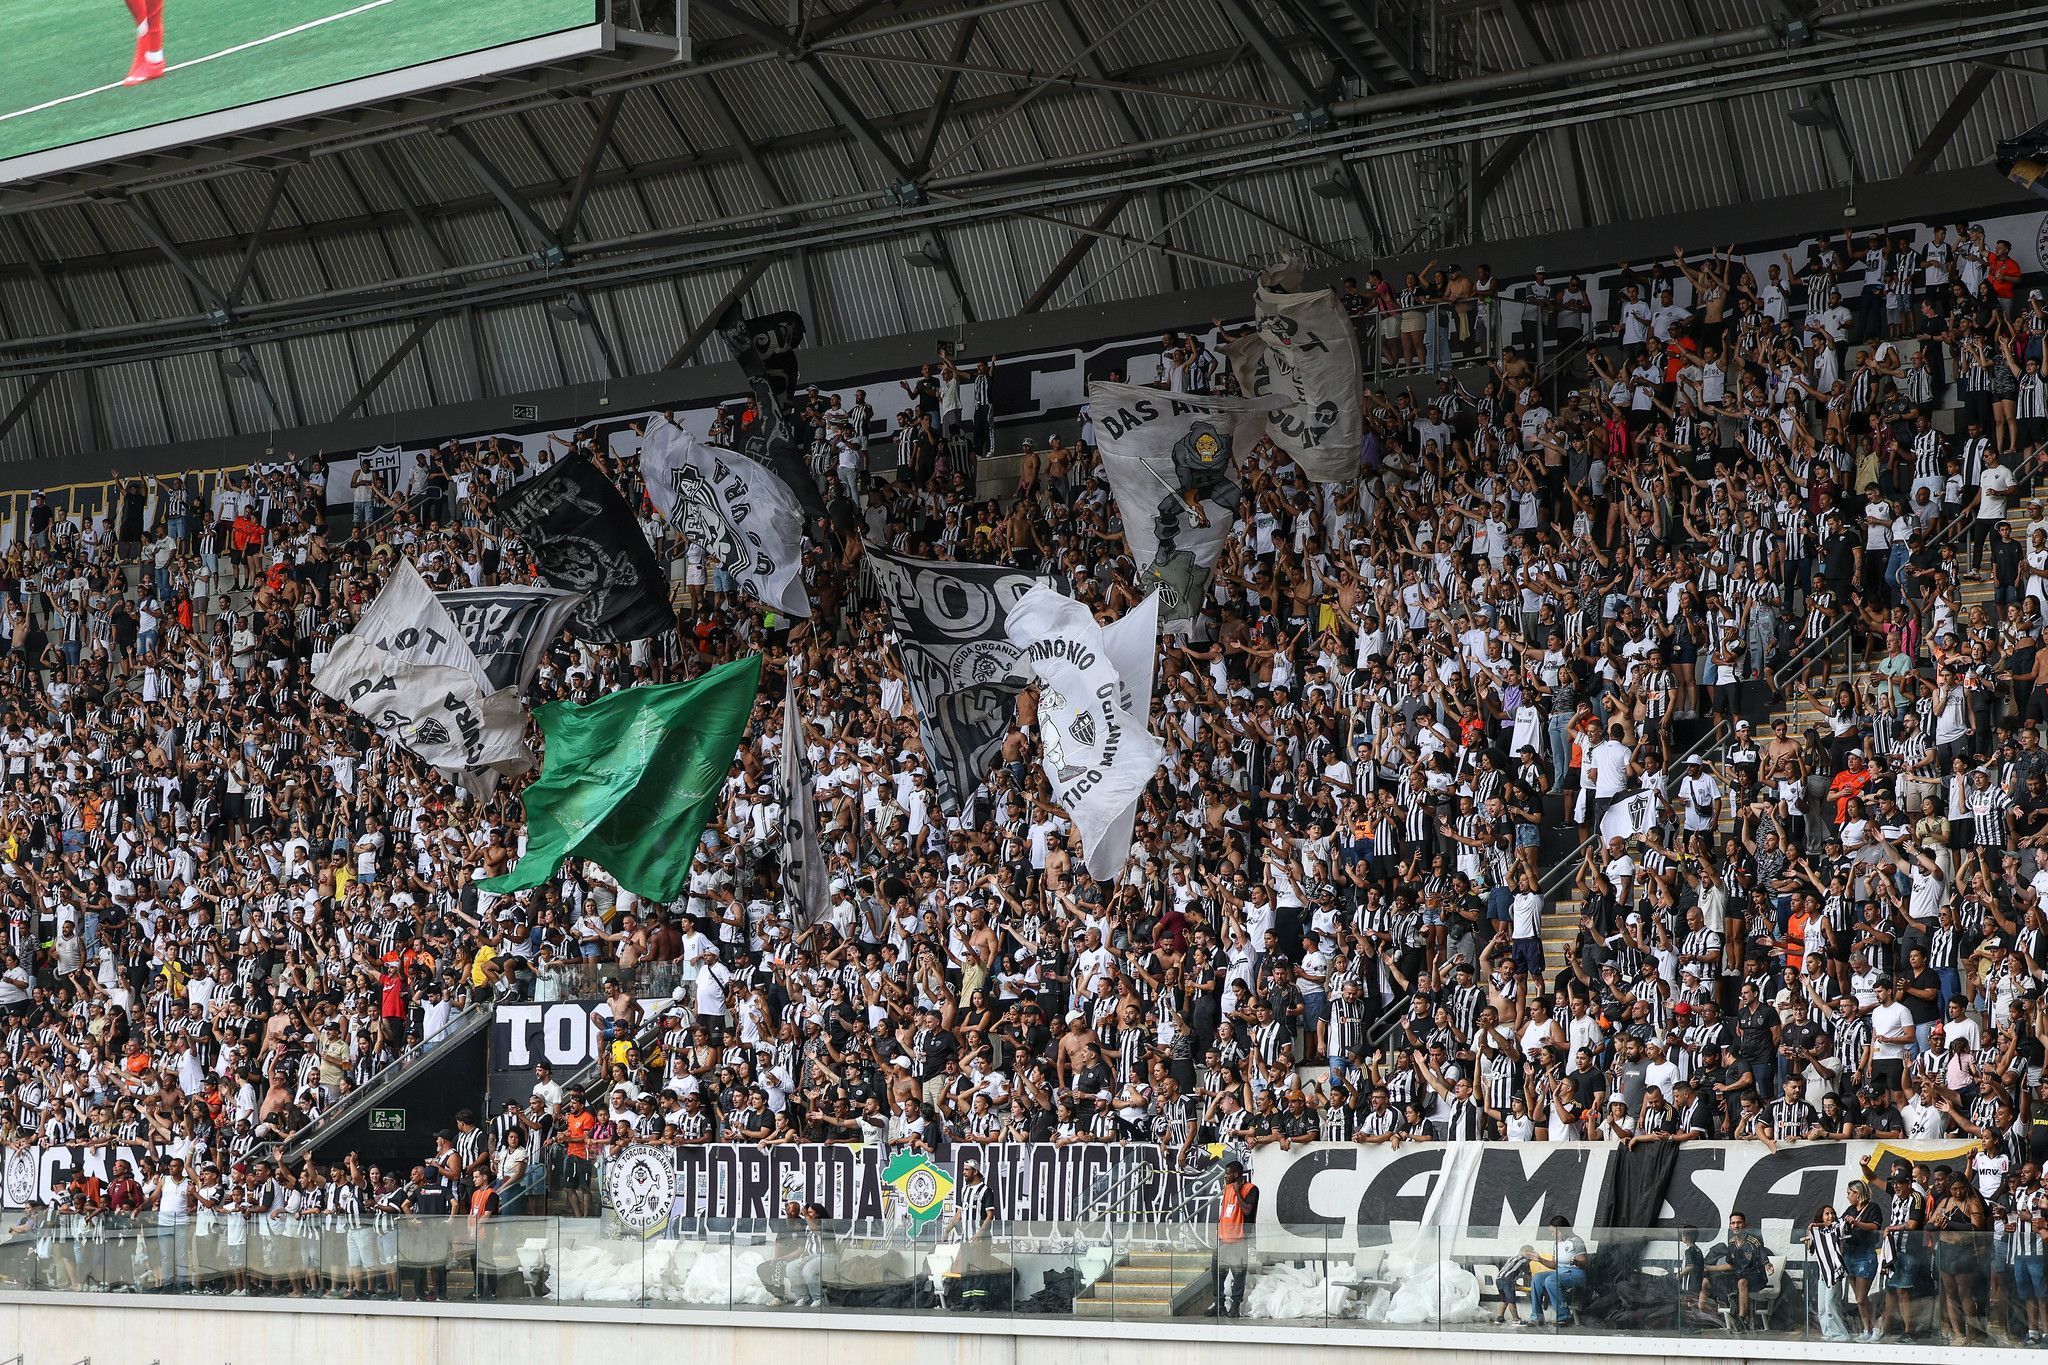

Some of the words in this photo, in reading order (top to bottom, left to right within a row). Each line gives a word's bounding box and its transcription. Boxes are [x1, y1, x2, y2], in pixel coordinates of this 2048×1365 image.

[1100, 400, 1159, 440] DAS
[953, 646, 975, 679] TORCIDA
[349, 674, 397, 703] DA
[1061, 768, 1104, 810] TICO
[622, 1147, 647, 1163] TORCIDA
[648, 1148, 674, 1191] ORGANIZADA
[677, 1144, 886, 1239] TORCIDA
[615, 1199, 671, 1227] GALOUCURA
